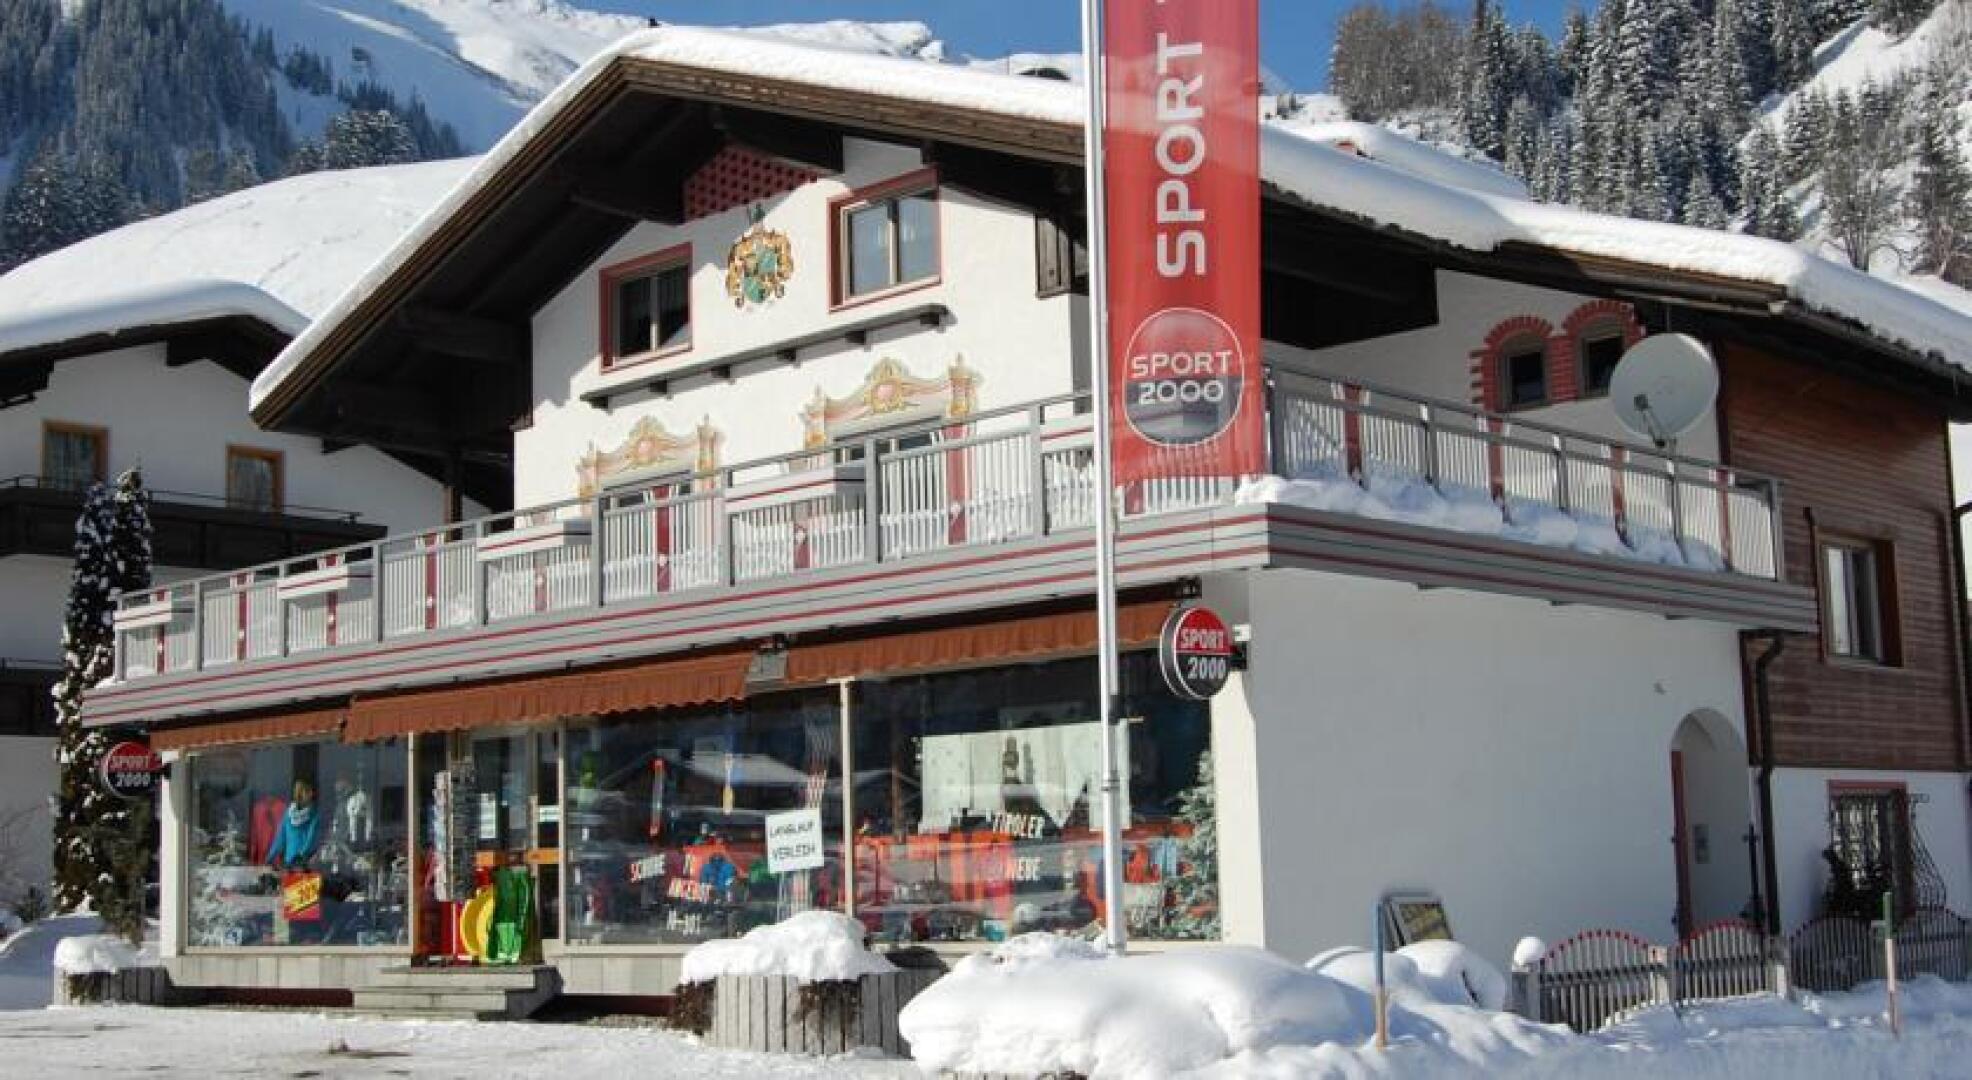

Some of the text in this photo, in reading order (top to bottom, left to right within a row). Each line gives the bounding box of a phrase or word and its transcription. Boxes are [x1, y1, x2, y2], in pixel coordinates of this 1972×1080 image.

[1156, 32, 1206, 278] SPORT
[1131, 350, 1233, 378] SPORT
[1138, 379, 1224, 405] 2000
[1180, 627, 1224, 649] SPORT
[1187, 656, 1227, 680] 2000
[109, 755, 149, 769] SPORT
[115, 771, 151, 788] 2000
